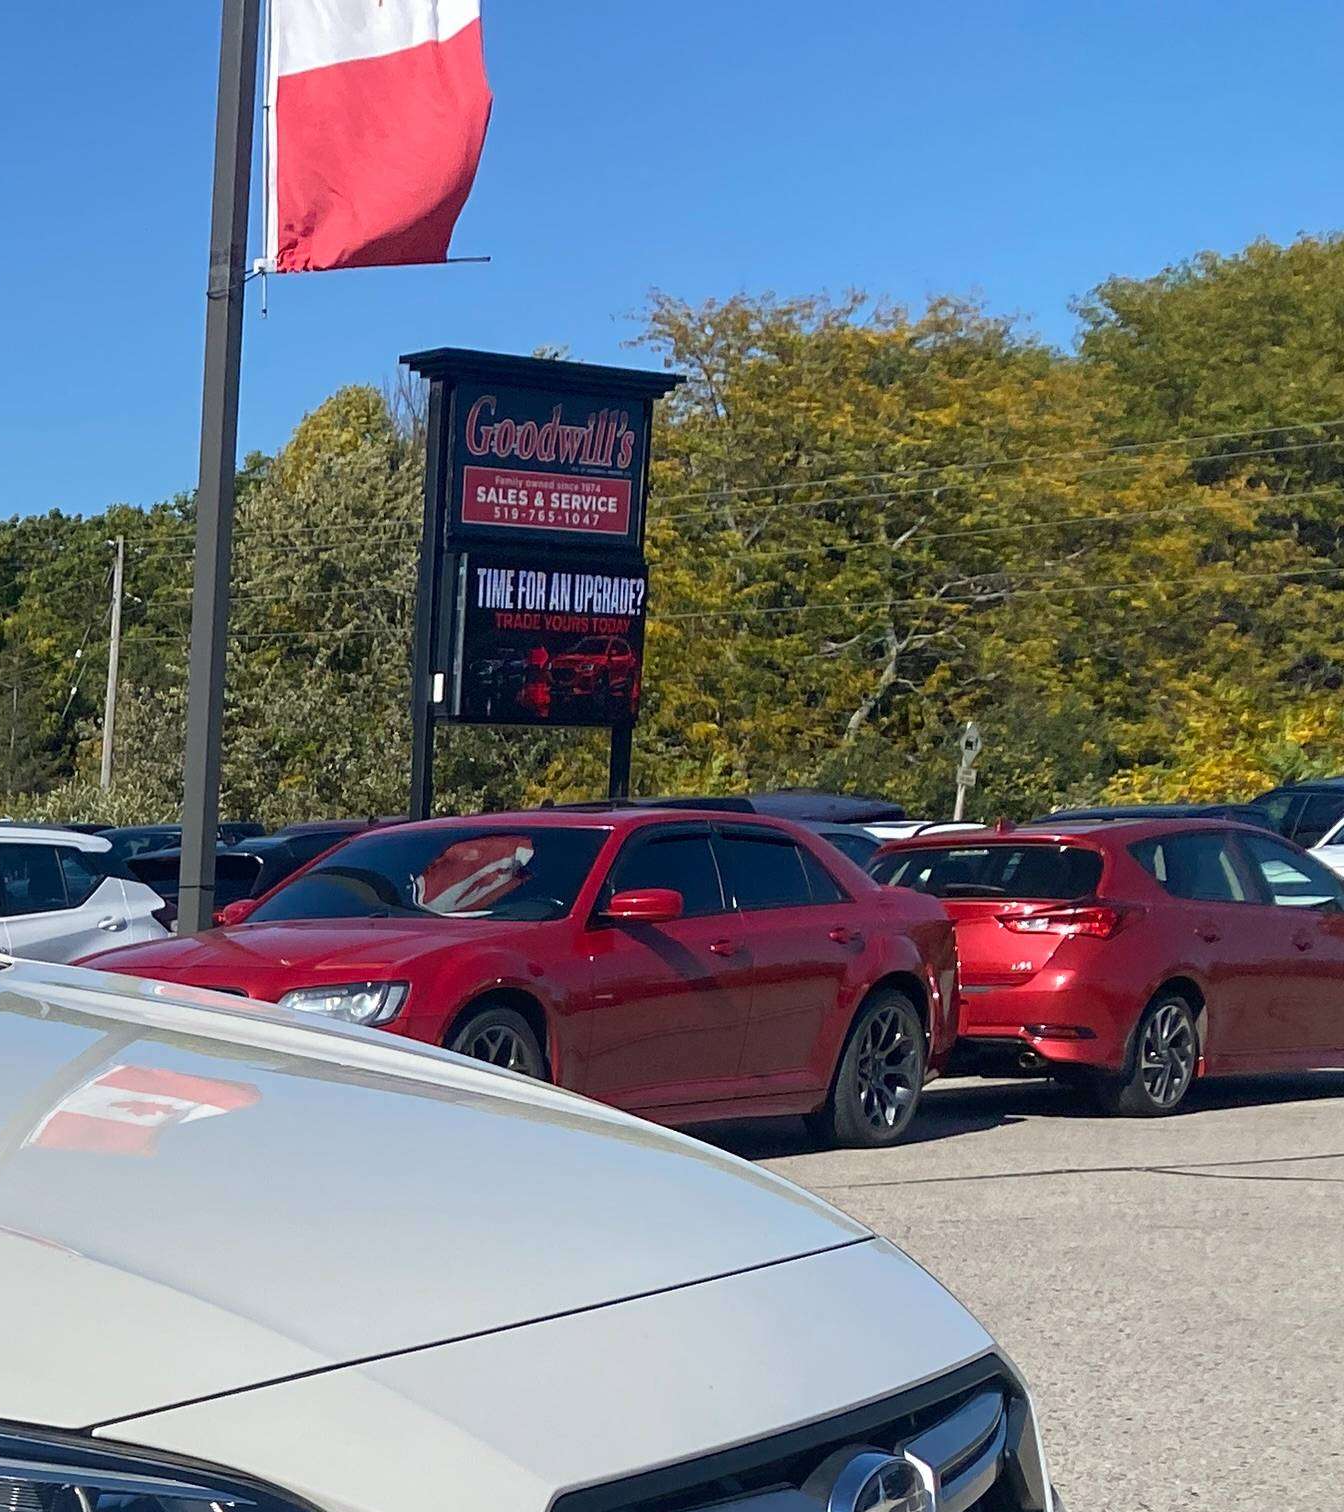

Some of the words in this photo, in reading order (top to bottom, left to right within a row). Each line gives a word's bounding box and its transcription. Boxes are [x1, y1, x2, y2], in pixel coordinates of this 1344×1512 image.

[465, 394, 635, 469] Goodwill's
[494, 475, 523, 489] Family
[525, 479, 555, 490] owned
[556, 481, 580, 491] since
[476, 486, 528, 506] SALES
[533, 491, 545, 507] &
[550, 492, 619, 513] SERVICE
[493, 506, 600, 527] 519-765-1047
[476, 567, 516, 610] TIME
[517, 570, 547, 611] FOR
[548, 572, 572, 612] AN
[574, 574, 645, 616] UPGRADE?
[495, 612, 541, 630] TRADE
[543, 614, 590, 633] YOURS
[591, 616, 632, 634] TODAY
